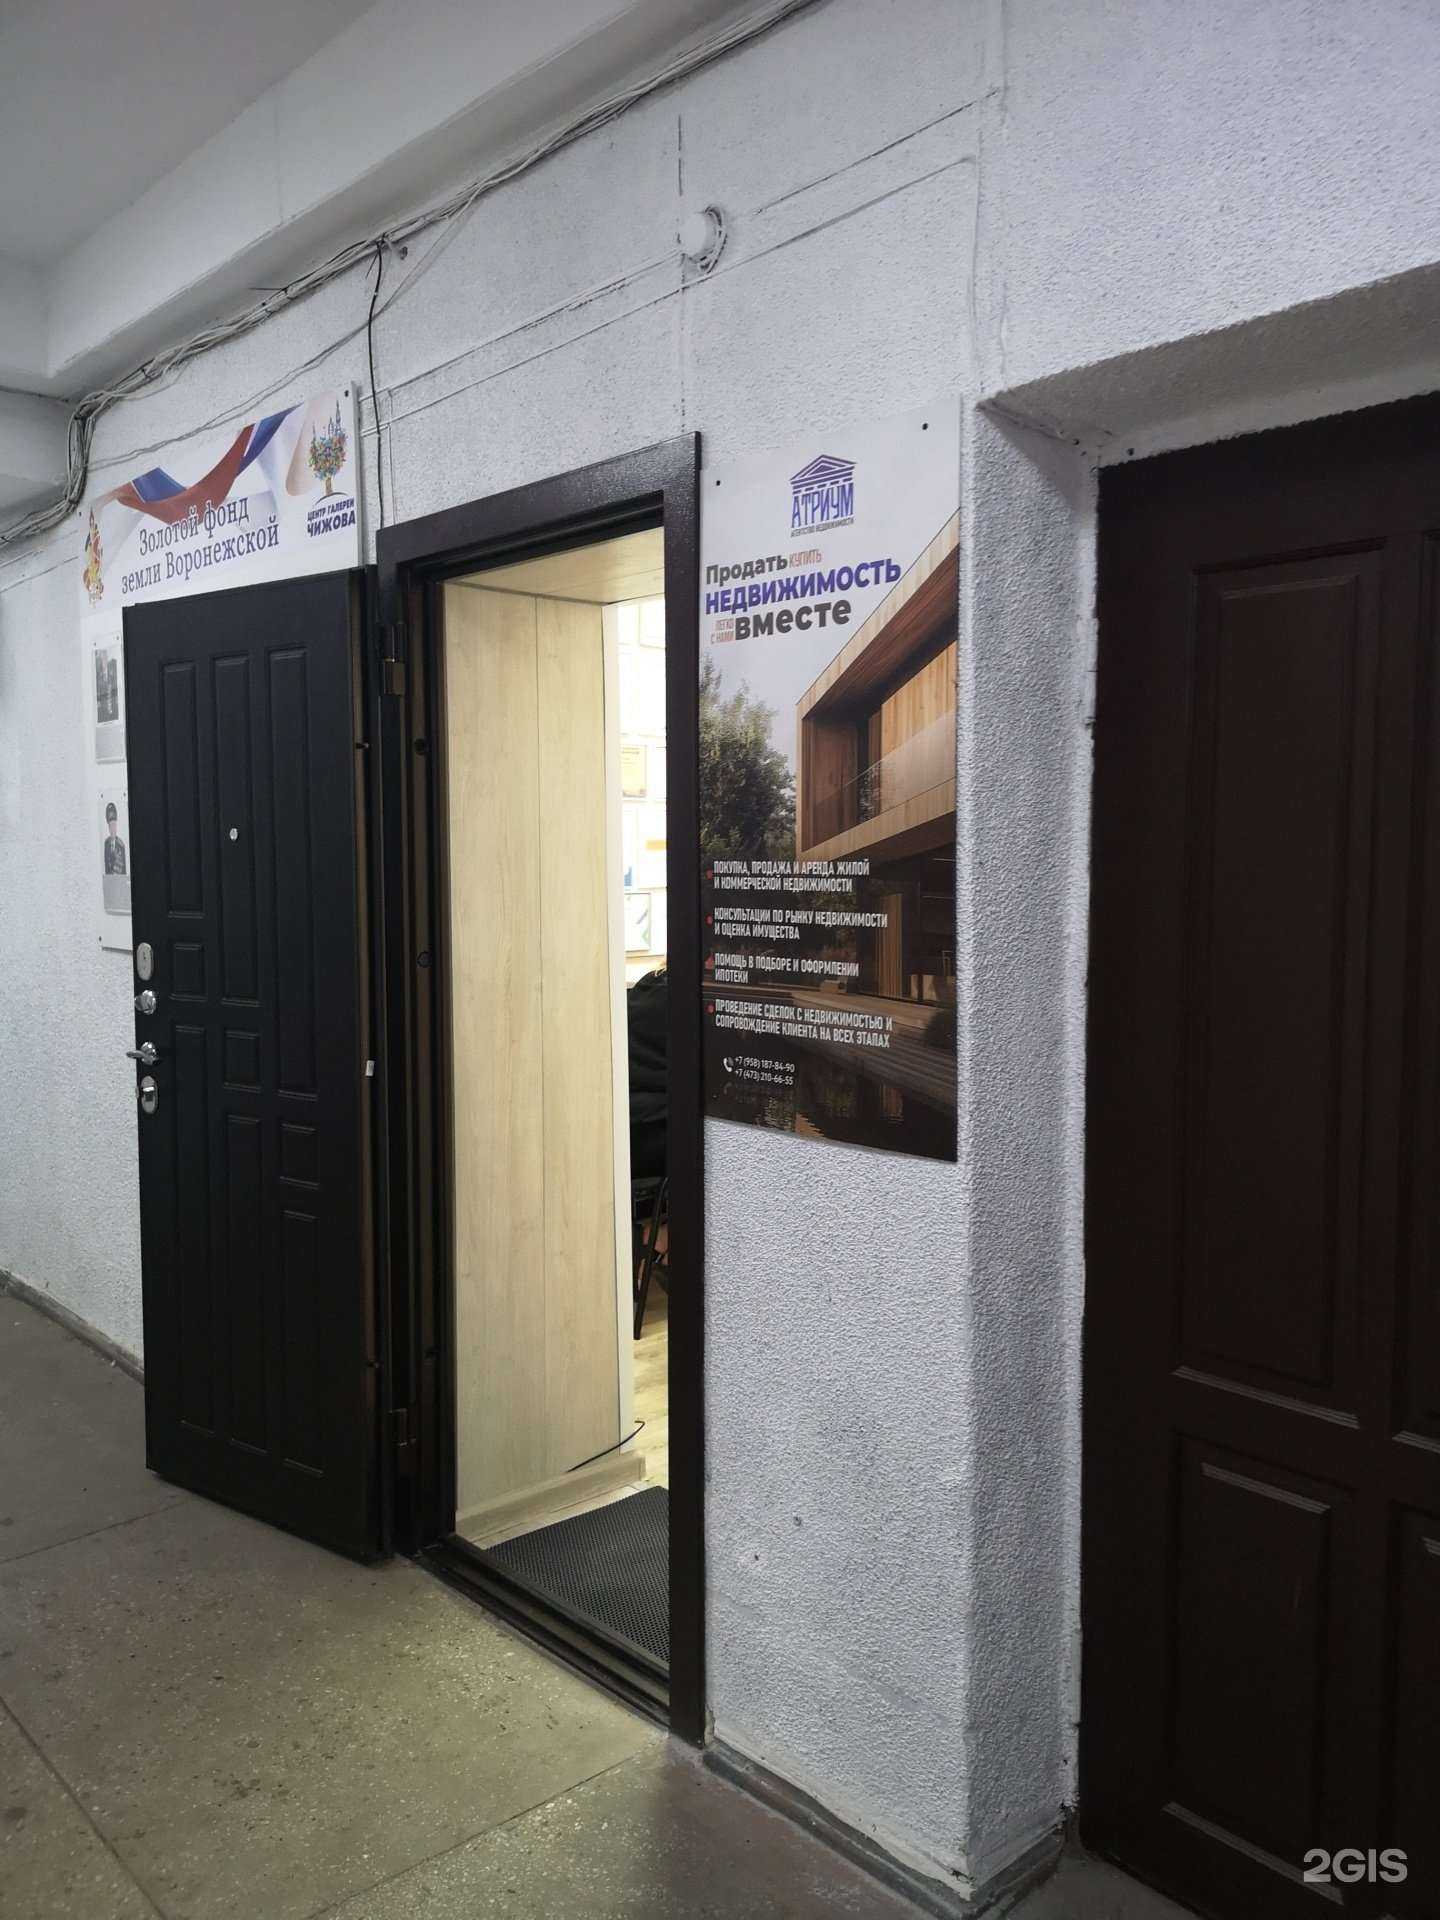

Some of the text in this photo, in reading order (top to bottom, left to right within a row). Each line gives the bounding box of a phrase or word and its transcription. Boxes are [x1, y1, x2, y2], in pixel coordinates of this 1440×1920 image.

[307, 507, 326, 522] ЦЕНТР
[791, 482, 854, 528] АТРИУМ
[139, 496, 250, 556] Золотой фонд
[307, 510, 356, 538] ЧИЖОВА
[121, 518, 280, 595] земли Воронежской
[706, 549, 822, 587] Продать КУПИТЬ
[705, 558, 901, 615] НЕДВИЖИМОСТЬ
[714, 859, 870, 877] ПОКУПКА, ПРОДАЖА И АРЕНДА ЖИЛОЙ
[714, 875, 852, 893] И КОММЕРЧЕСКОЙ НЕДВИЖИМОСТИ
[714, 907, 888, 928] КОНСУЛЬТАЦИИ ПО РЫНКУ НЕДВИЖИМОСТИ
[714, 923, 800, 940] И ОЦЕНКА ИМУЩЕСТВА
[715, 953, 859, 976] ПОМОЩЬ В ПОДБОРЕ И ОФОРМЛЕНИИ
[715, 969, 749, 984] ИПОТЕКИ
[715, 999, 892, 1030] ПРОВЕДЕНИЕ СДЕЛОК С НЕДВИЖИМОСТЬЮ И
[715, 1015, 890, 1048] СОПРОВОЖДЕНИЕ КЛИЕНТА НА ВСЕХ ЭТАПАХ
[735, 1056, 795, 1072] +7 (958) 187-84-90
[743, 1070, 760, 1081] (473)
[760, 1073, 793, 1085] 210-66-55
